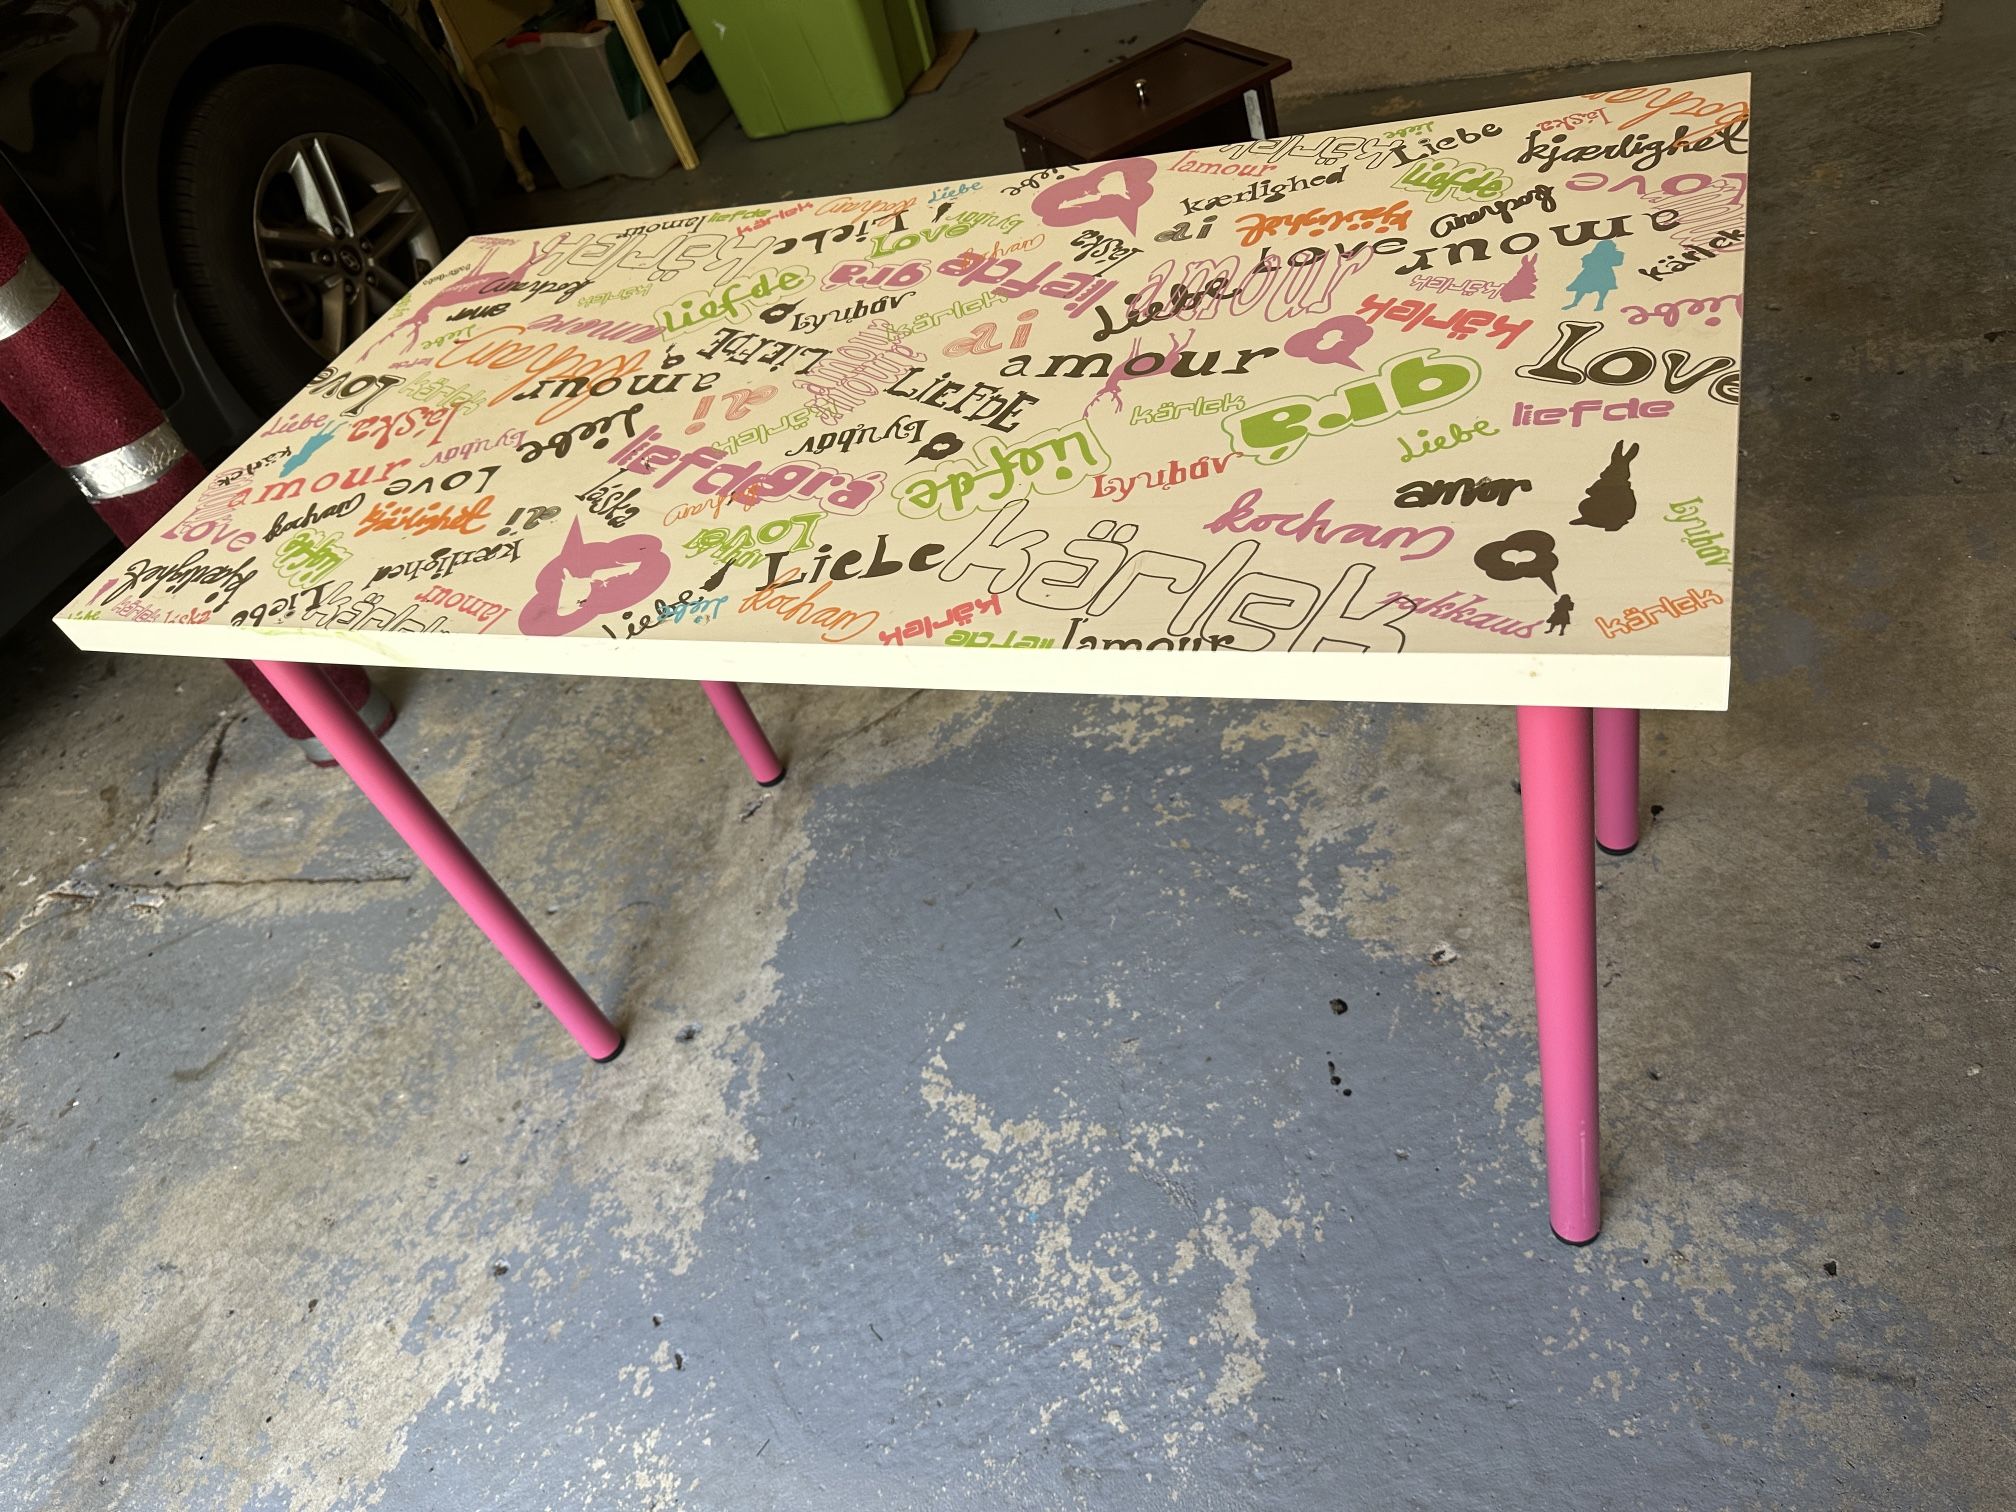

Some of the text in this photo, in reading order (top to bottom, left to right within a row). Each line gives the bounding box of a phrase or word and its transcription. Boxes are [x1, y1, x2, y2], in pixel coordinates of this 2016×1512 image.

[1390, 122, 1503, 169] Liebe
[1516, 115, 1749, 173] kjærlighet
[1180, 165, 1349, 215] kærlighed
[1395, 160, 1510, 201] liefde
[707, 208, 772, 224] liefde
[736, 201, 814, 238] kärlek
[772, 209, 909, 256] Liebe
[1070, 229, 1145, 277] láska
[1395, 208, 1680, 276] amour
[657, 267, 811, 341] liefde
[1409, 275, 1505, 300] kärlek
[1356, 293, 1534, 350] kärlek
[512, 372, 722, 401] amour
[1000, 345, 1280, 379] amour
[1129, 392, 1246, 426] kärlek
[1512, 397, 1676, 428] liefde
[228, 458, 412, 509] amour
[575, 468, 642, 528] láska
[1393, 477, 1532, 509] amor
[362, 538, 525, 591] kærlighed
[756, 533, 945, 592] Liebe
[938, 498, 1417, 653] kärlek
[878, 592, 1003, 647] kärlek
[1595, 588, 1724, 640] kärlek
